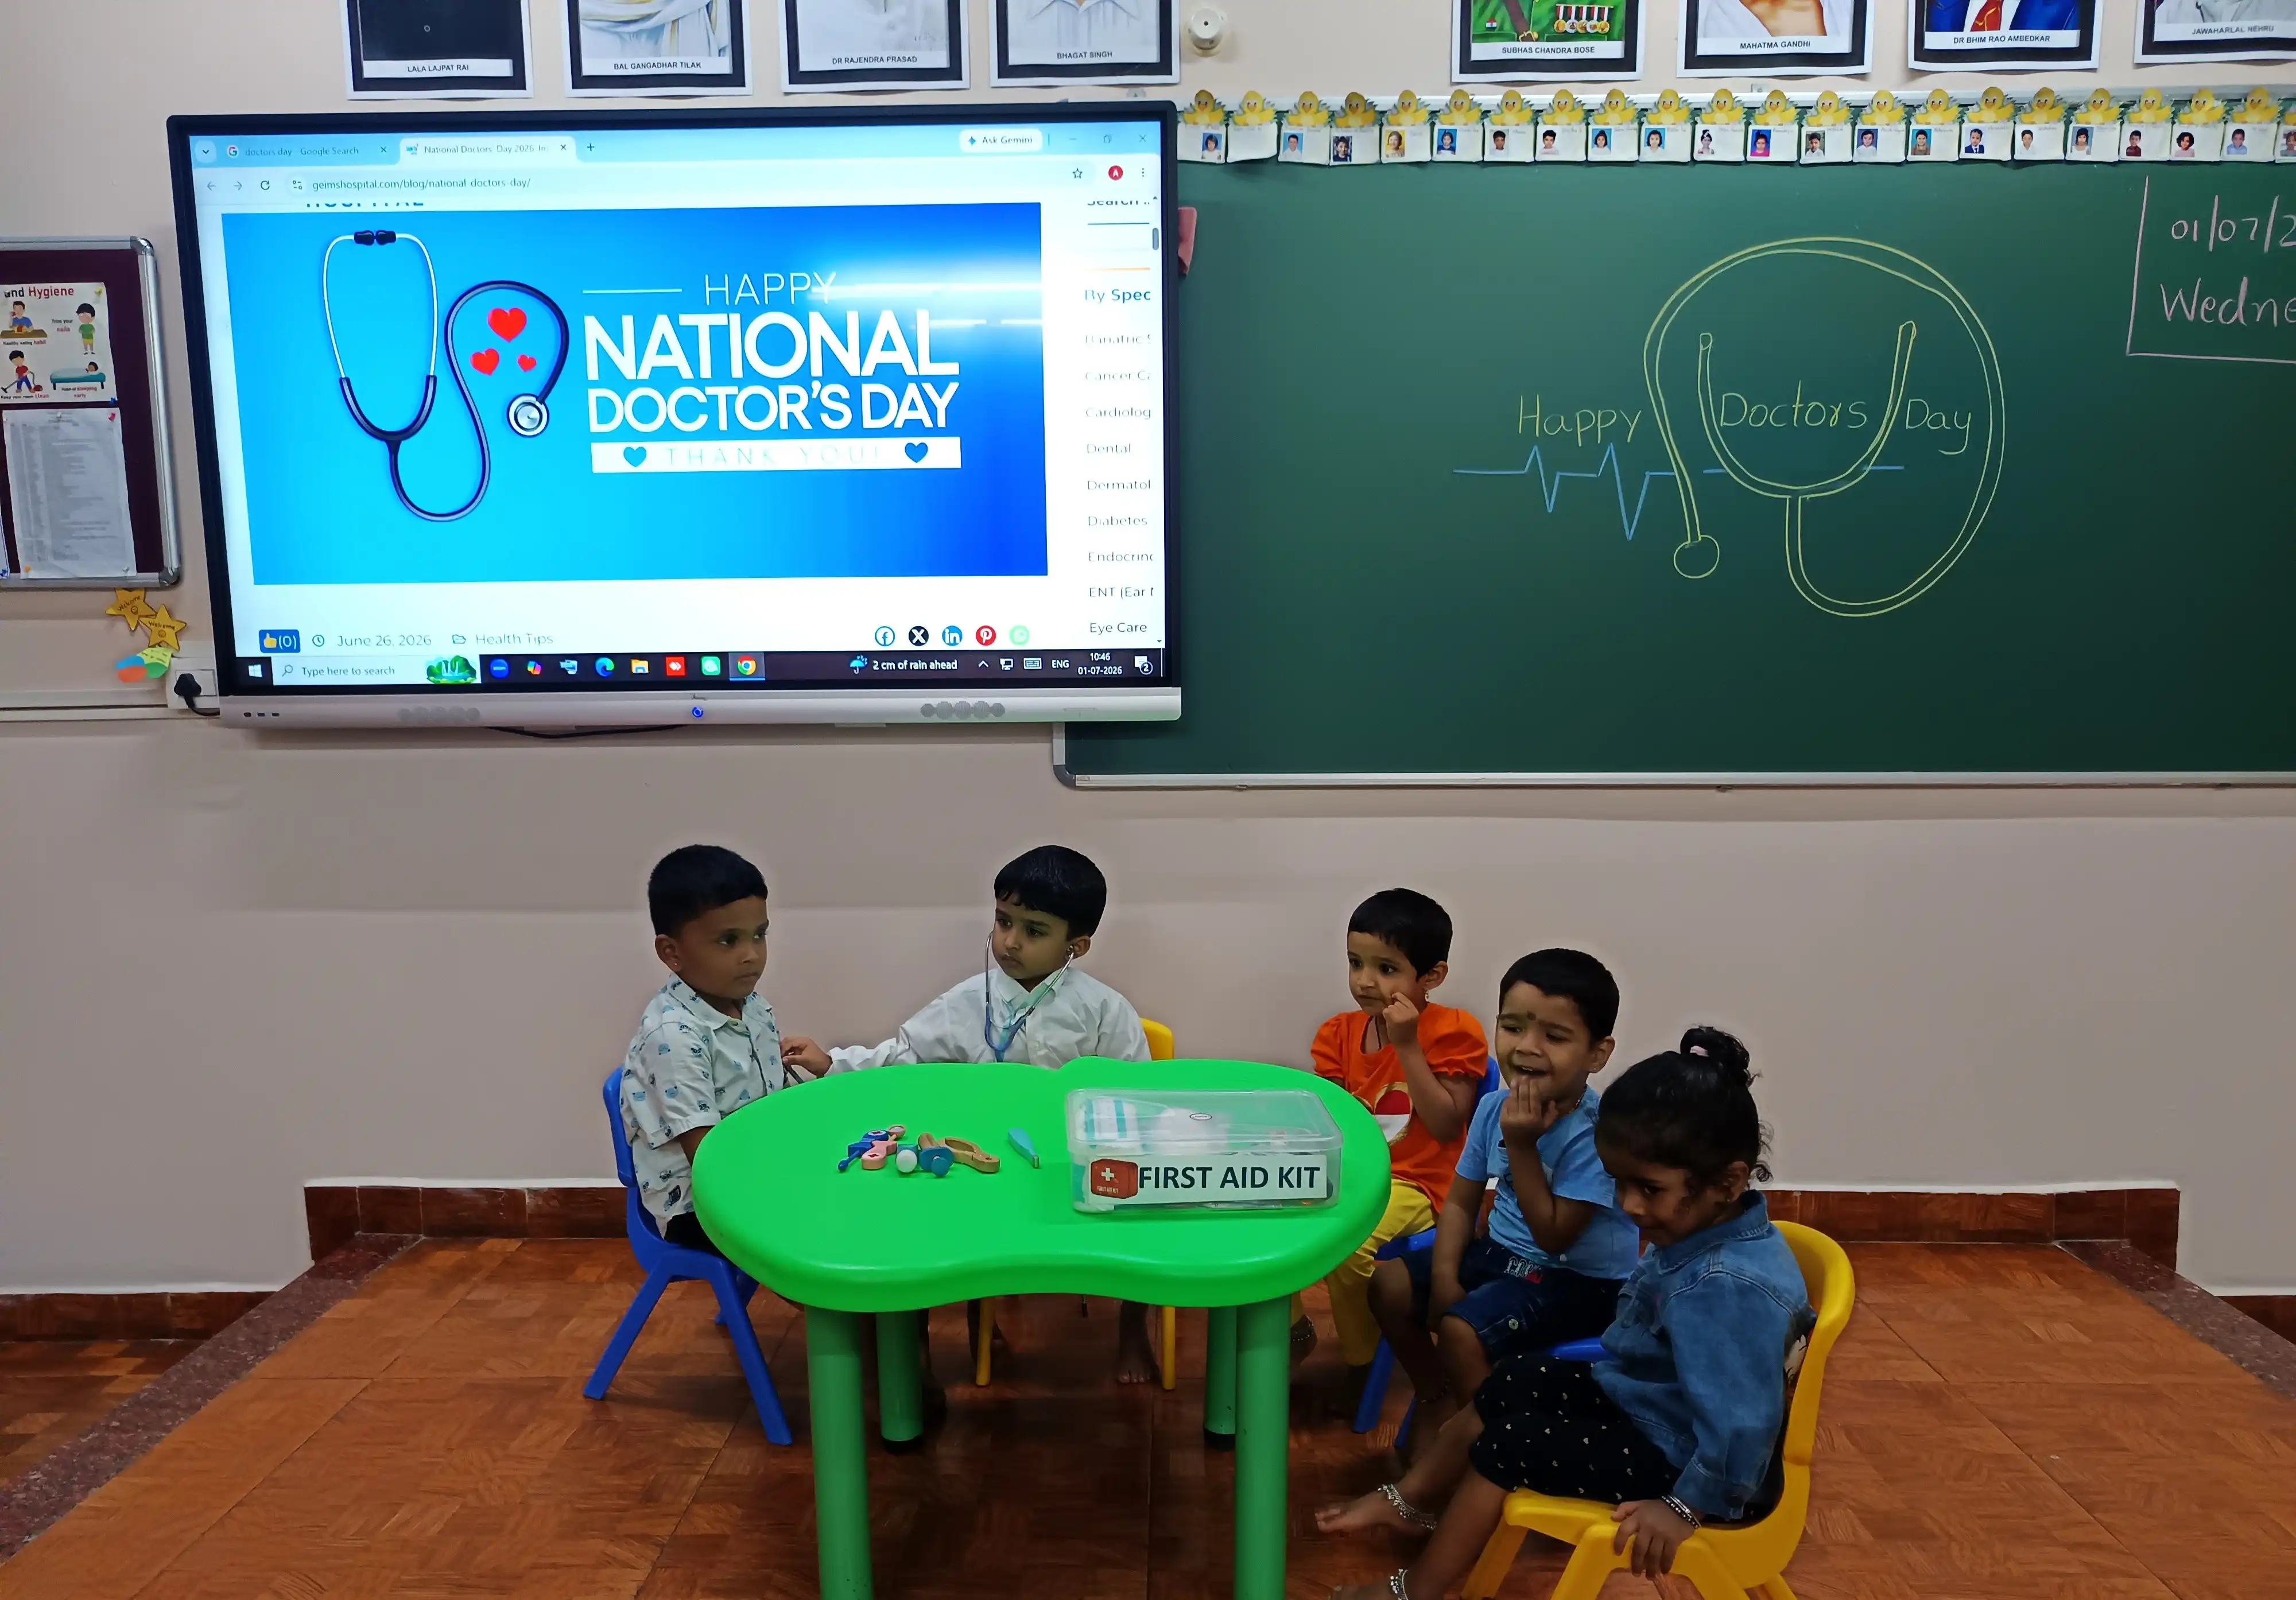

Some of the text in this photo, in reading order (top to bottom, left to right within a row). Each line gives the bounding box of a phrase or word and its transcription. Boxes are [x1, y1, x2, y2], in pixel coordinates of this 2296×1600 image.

[1953, 36, 1964, 44] DR
[2007, 34, 2050, 43] AMBEDKAR
[1740, 40, 1810, 49] MAHATMA GANDHI
[1502, 45, 1595, 55] SUBHAS CHANDRA BOSE
[844, 56, 885, 64] RAJENDRA
[428, 64, 454, 72] LAJPAT
[630, 61, 677, 70] GANGADHAR
[679, 61, 701, 69] TILAK
[300, 147, 329, 157] Google
[332, 147, 359, 156] Search
[28, 286, 74, 299] Hygiene
[704, 272, 837, 305] HAPPY
[1111, 289, 1150, 304] Spec
[584, 310, 960, 380] NATIONAL
[588, 380, 960, 433] DOCTOR'S DAY
[1519, 380, 1971, 454] Happy Doctors Day
[1087, 443, 1131, 453] Dental
[1088, 516, 1147, 526] Diabetes
[1089, 588, 1115, 597] ENT
[1090, 622, 1147, 635] Eye Care
[337, 635, 371, 647] June
[398, 634, 432, 646] 2026
[476, 632, 553, 648] Health Tips
[1090, 653, 1110, 661] 10:46
[873, 661, 879, 670] 2
[898, 660, 907, 670] of
[909, 660, 925, 670] rain
[927, 659, 957, 670] ahead
[1052, 660, 1069, 669] ENG
[302, 666, 395, 678] Type here to search
[1078, 666, 1122, 675] 01-07-2026
[1139, 1166, 1320, 1189] FIRST AID KIT
